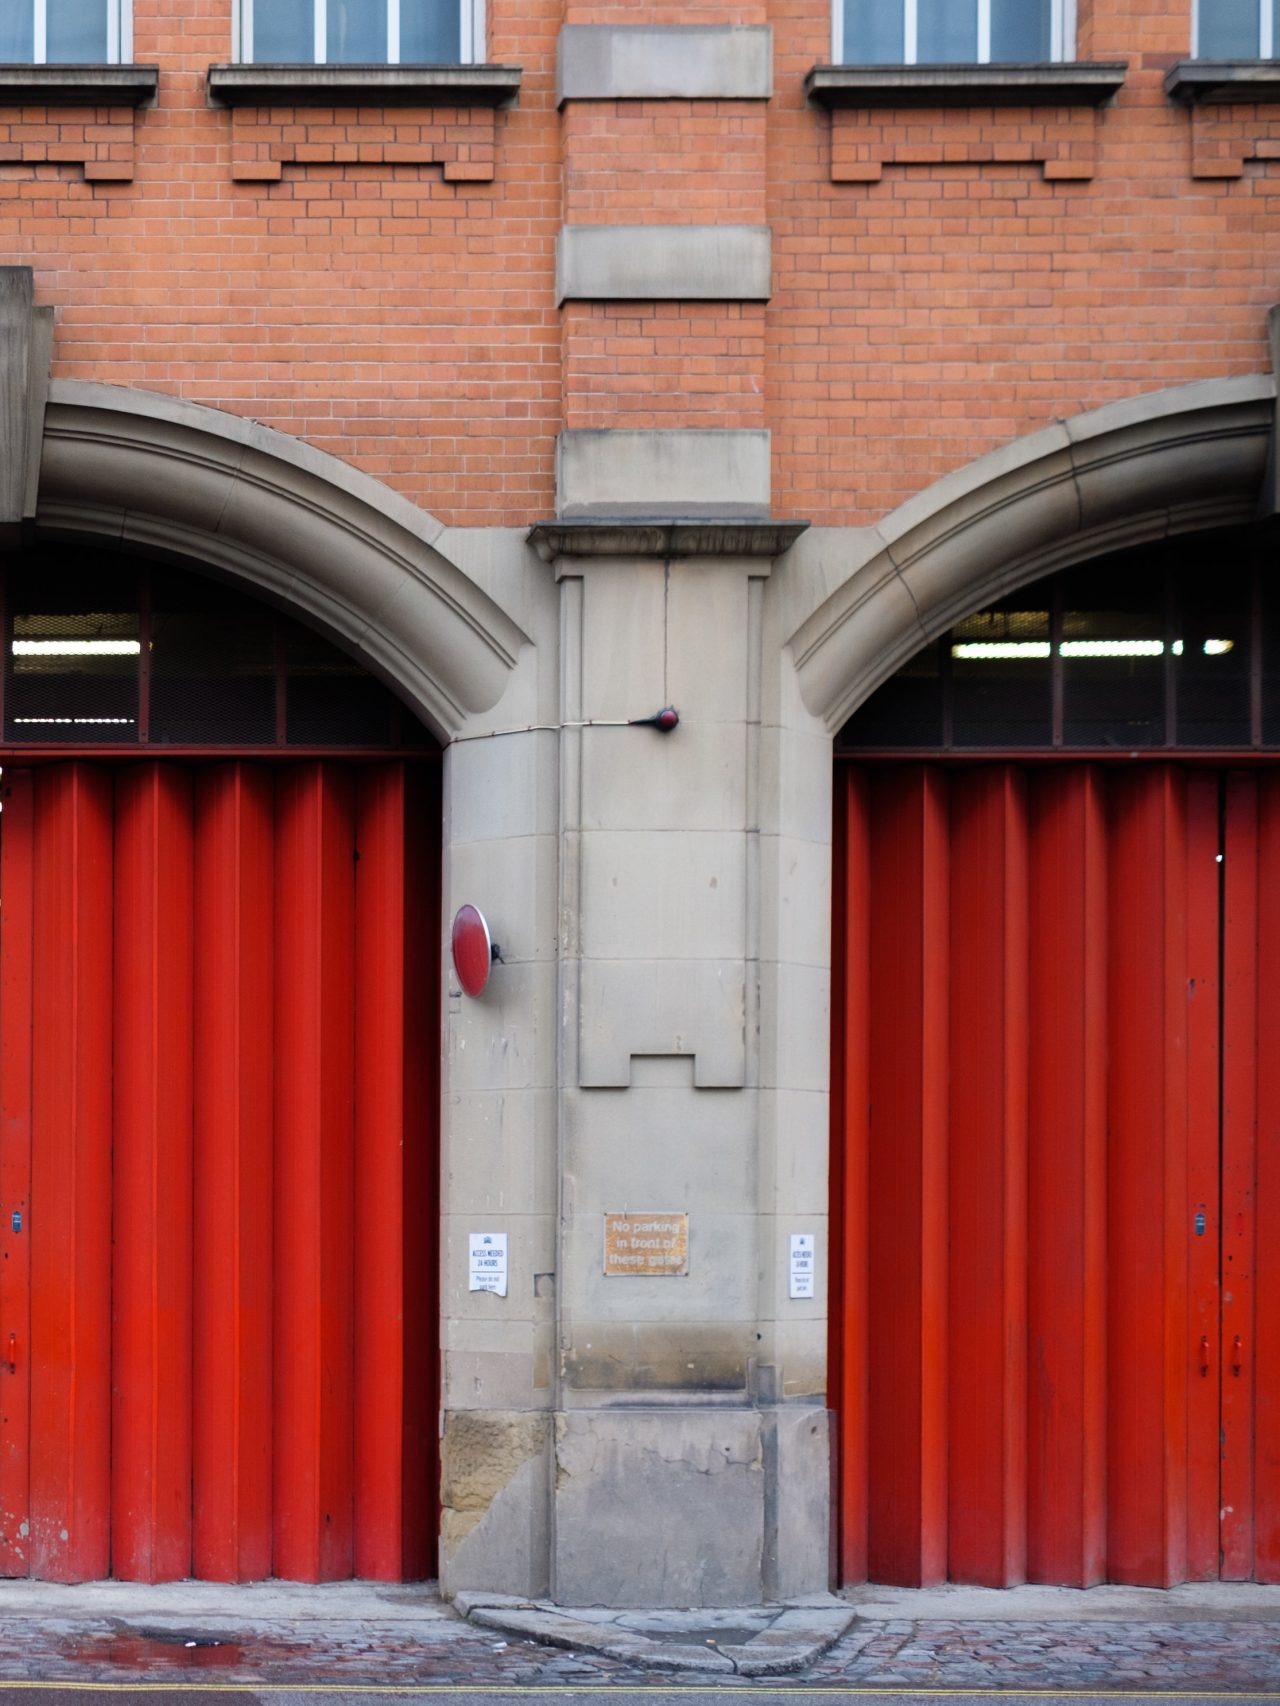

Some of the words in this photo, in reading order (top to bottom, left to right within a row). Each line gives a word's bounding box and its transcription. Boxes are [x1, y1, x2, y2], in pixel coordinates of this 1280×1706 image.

[612, 1221, 630, 1232] No
[633, 1221, 680, 1234] parking
[616, 1237, 628, 1248] in
[631, 1237, 660, 1248] front
[663, 1237, 677, 1248] of
[609, 1254, 645, 1265] these
